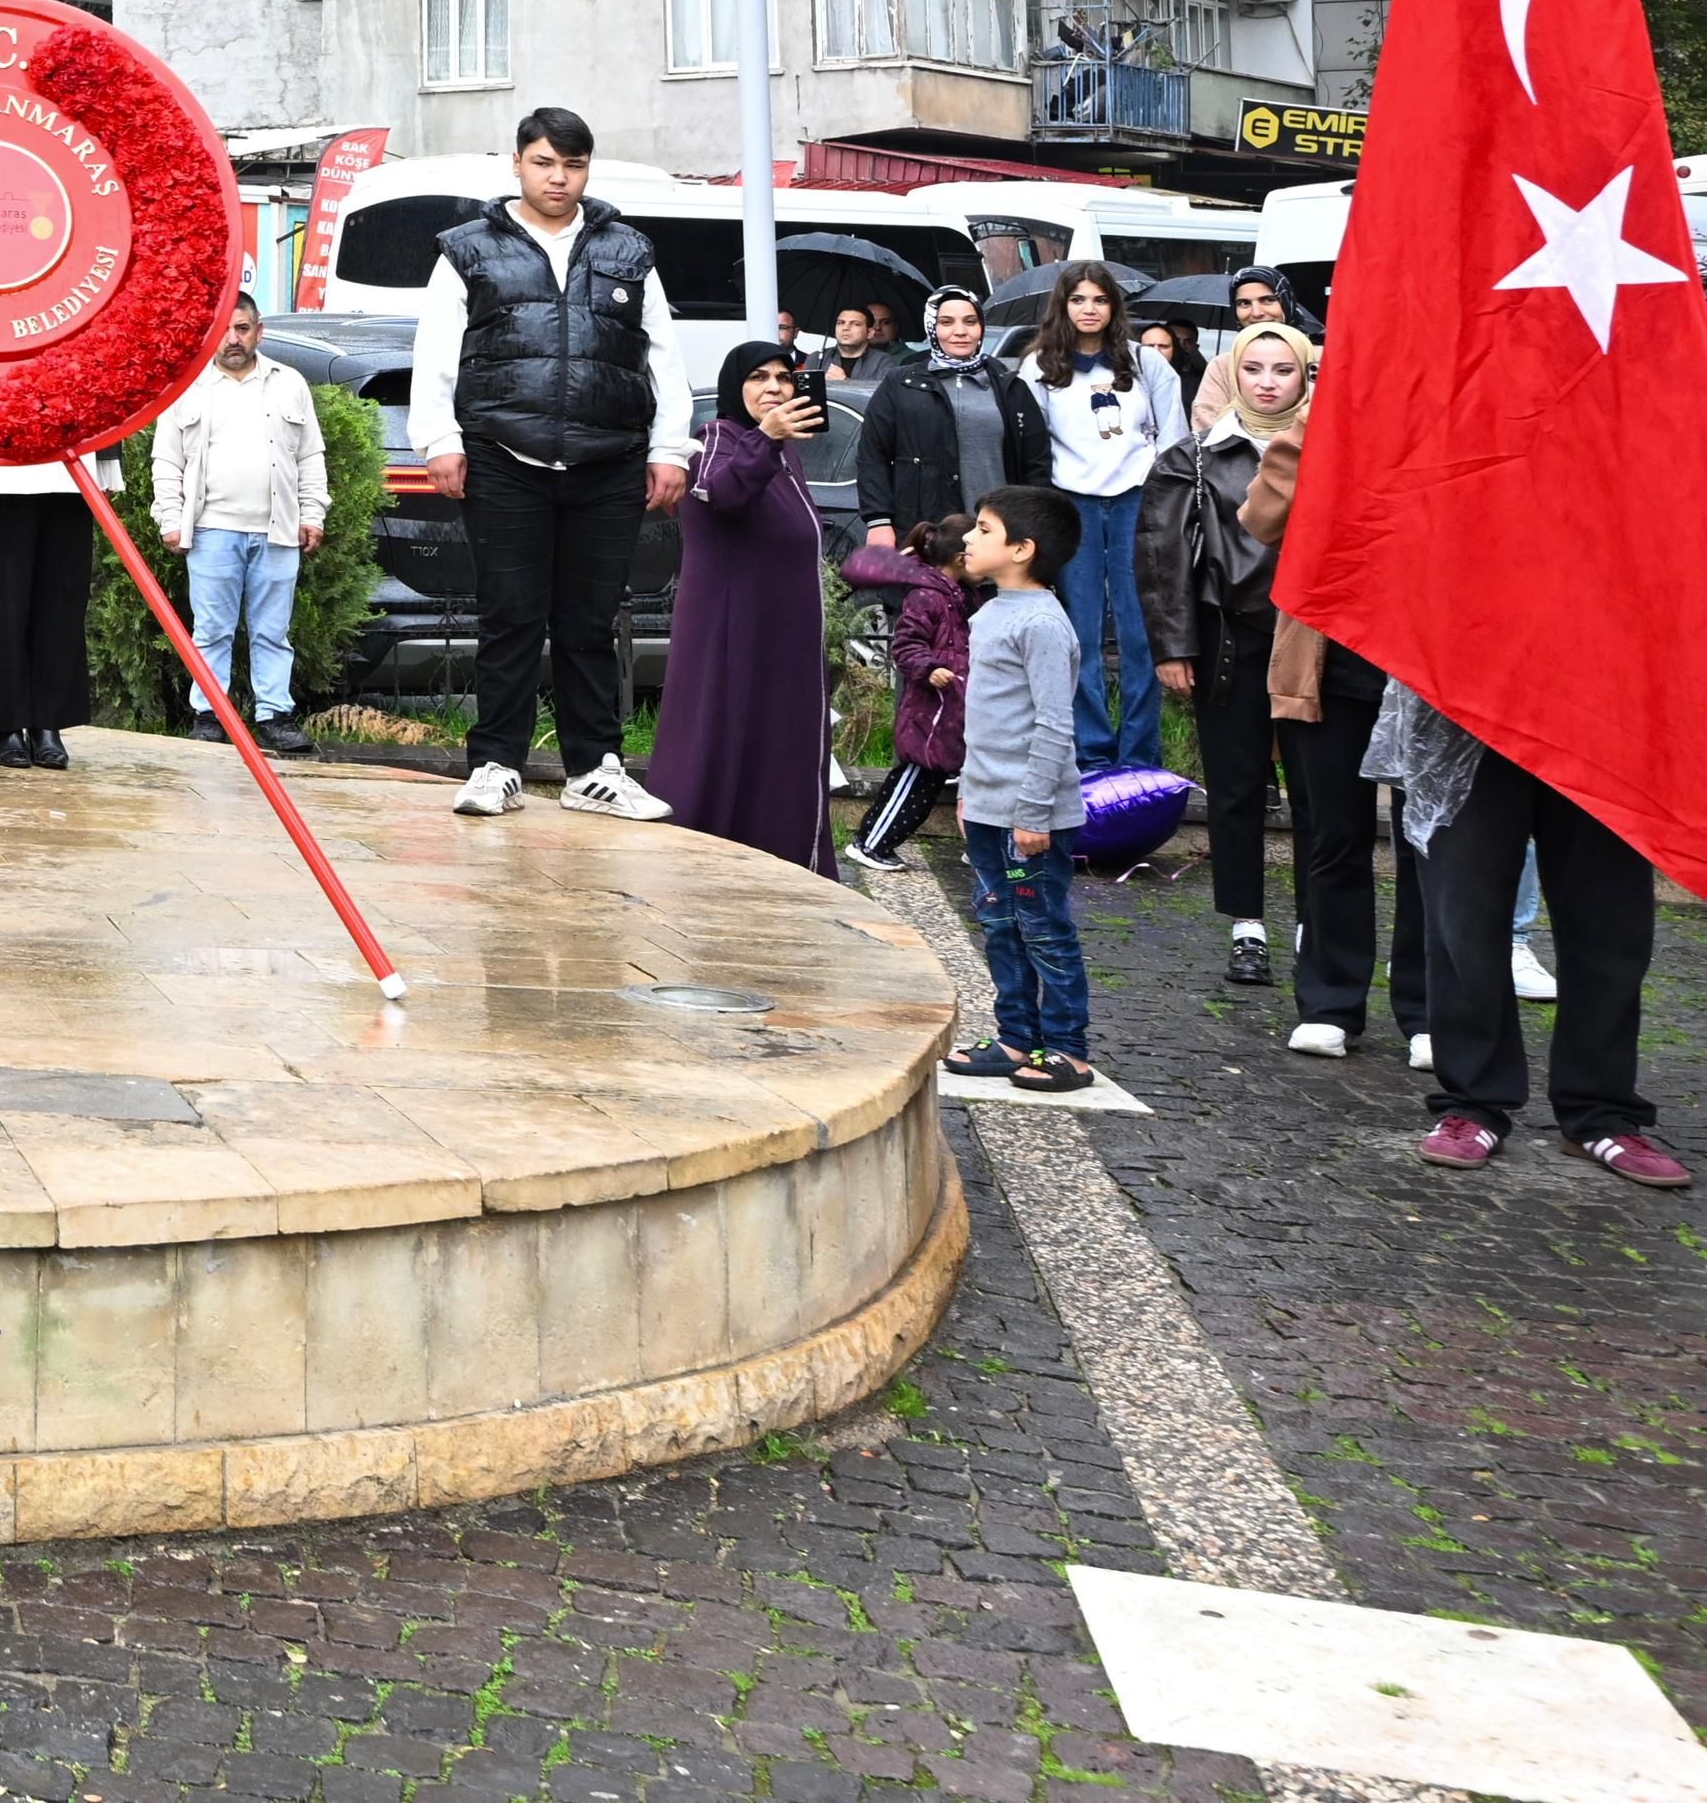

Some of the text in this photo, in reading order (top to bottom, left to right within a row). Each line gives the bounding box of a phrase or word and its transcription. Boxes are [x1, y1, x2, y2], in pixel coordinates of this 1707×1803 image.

[341, 141, 368, 154] BAK
[1294, 134, 1363, 157] STR
[335, 155, 371, 170] KÖŞE
[13, 243, 119, 340] BELEDİYESİ
